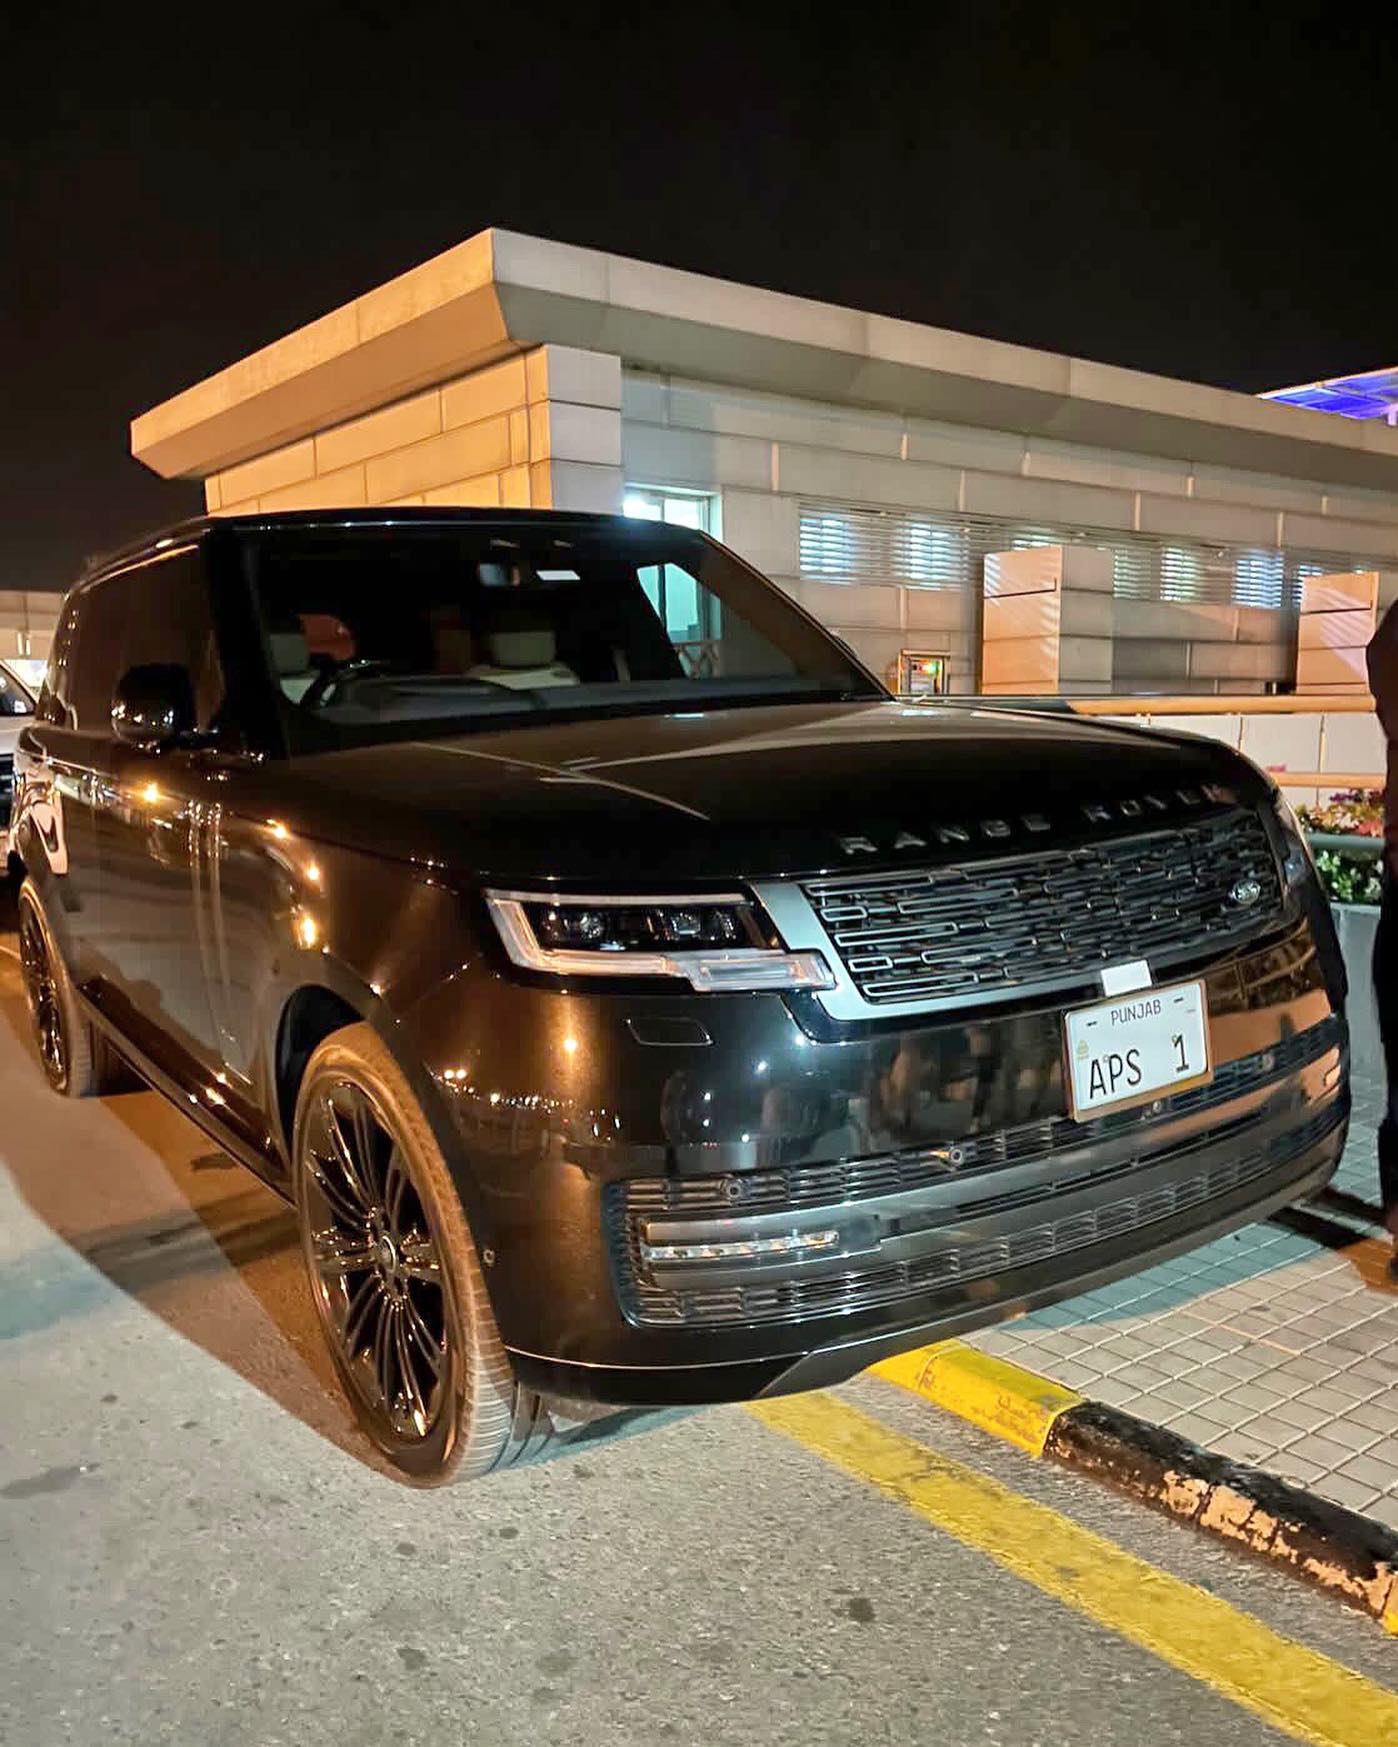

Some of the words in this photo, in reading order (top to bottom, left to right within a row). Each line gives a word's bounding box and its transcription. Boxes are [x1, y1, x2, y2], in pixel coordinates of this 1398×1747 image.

[1110, 999, 1162, 1026] PUNJAB
[1089, 1048, 1142, 1099] APS
[1173, 1033, 1190, 1072] 1
